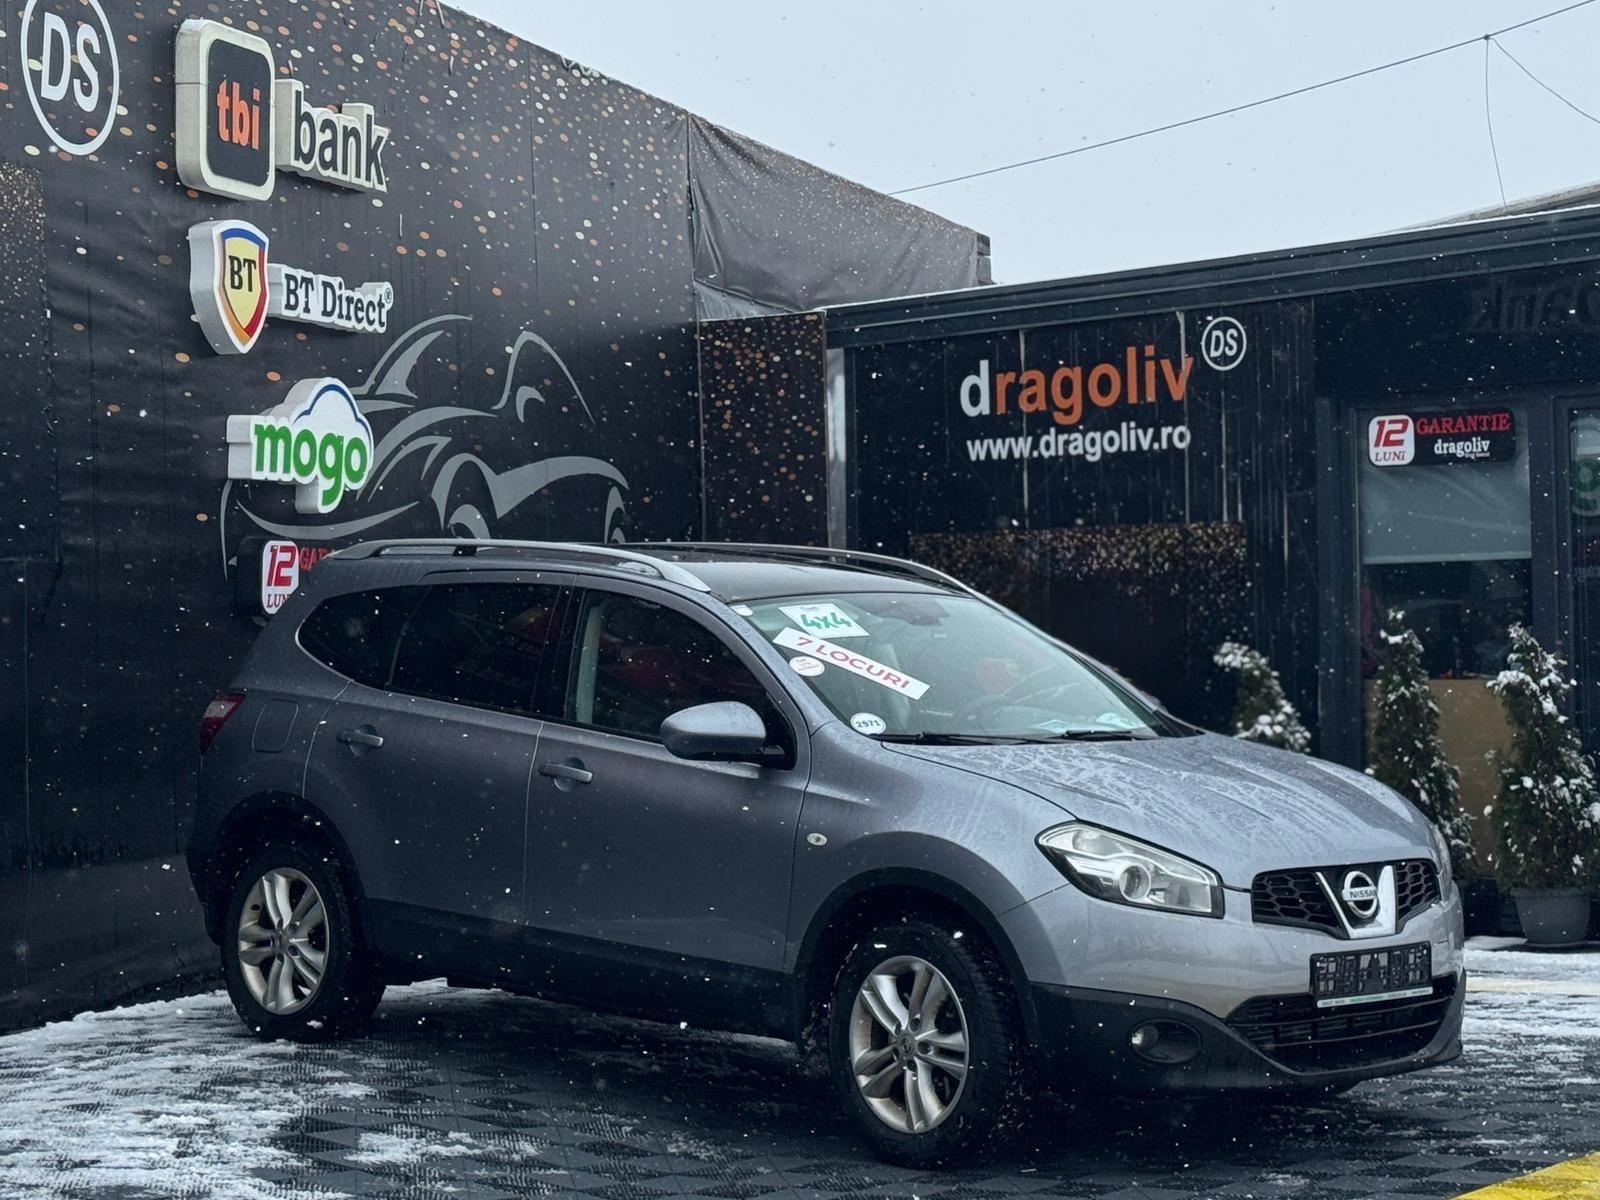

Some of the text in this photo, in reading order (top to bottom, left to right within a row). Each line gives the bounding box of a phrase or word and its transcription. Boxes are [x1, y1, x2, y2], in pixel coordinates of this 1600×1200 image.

[41, 12, 101, 112] DS
[217, 80, 384, 185] tbi bank
[228, 255, 257, 292] BT
[284, 273, 314, 313] BT
[1209, 327, 1238, 358] DS
[960, 345, 1194, 426] dragoliv
[966, 421, 1191, 462] www.dragoliv.ro
[1373, 418, 1409, 448] 12
[1416, 413, 1511, 435] GARANTIE
[254, 424, 368, 506] mogo
[1434, 436, 1491, 457] dragoliv
[266, 545, 297, 586] 12
[797, 636, 813, 646] 7
[815, 644, 910, 689] LOCURI
